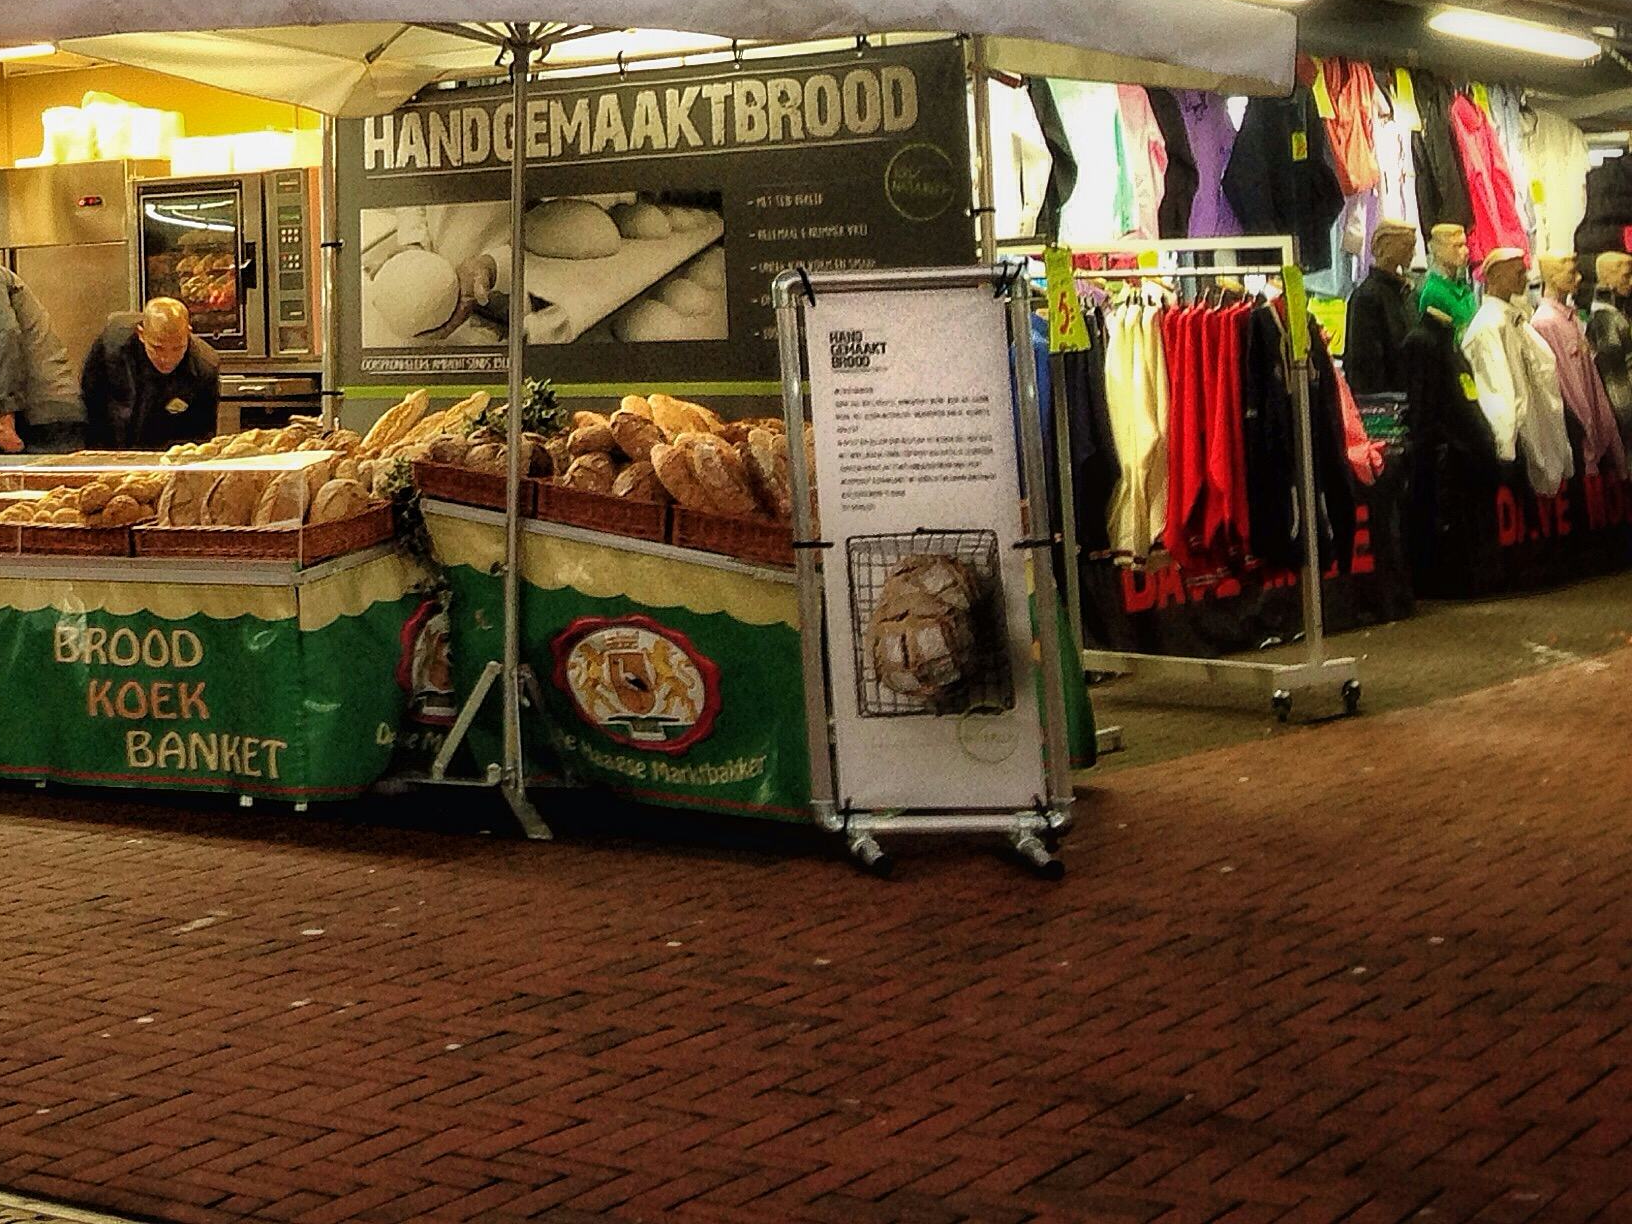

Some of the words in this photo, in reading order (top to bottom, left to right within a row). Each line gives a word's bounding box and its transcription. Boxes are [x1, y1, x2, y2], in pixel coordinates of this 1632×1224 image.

[53, 626, 205, 668] BROOD
[85, 679, 211, 720] KOEK
[125, 730, 289, 780] BANKET
